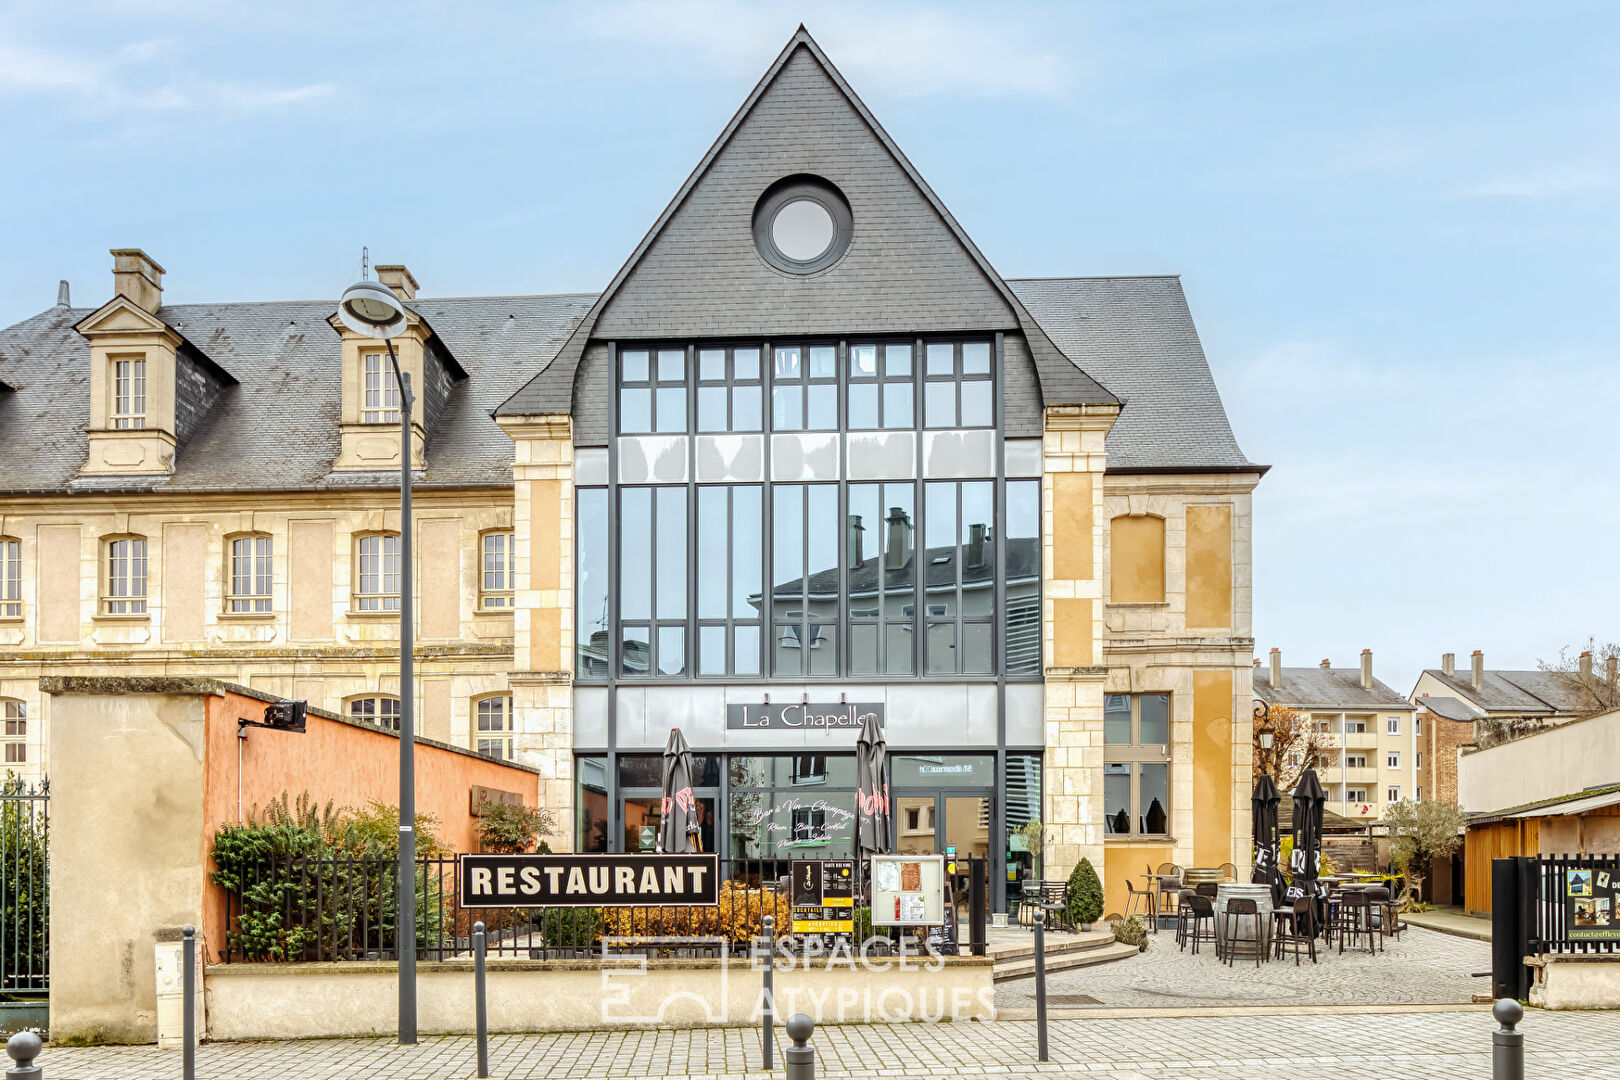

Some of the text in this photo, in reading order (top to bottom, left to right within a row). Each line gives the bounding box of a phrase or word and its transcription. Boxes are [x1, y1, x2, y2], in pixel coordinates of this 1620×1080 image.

[743, 705, 867, 736] La Chapelle
[753, 808, 774, 825] Bar
[783, 797, 801, 813] Vin
[811, 799, 855, 821] Champagn
[767, 822, 787, 832] Rhum
[471, 866, 707, 895] RESTAURANT
